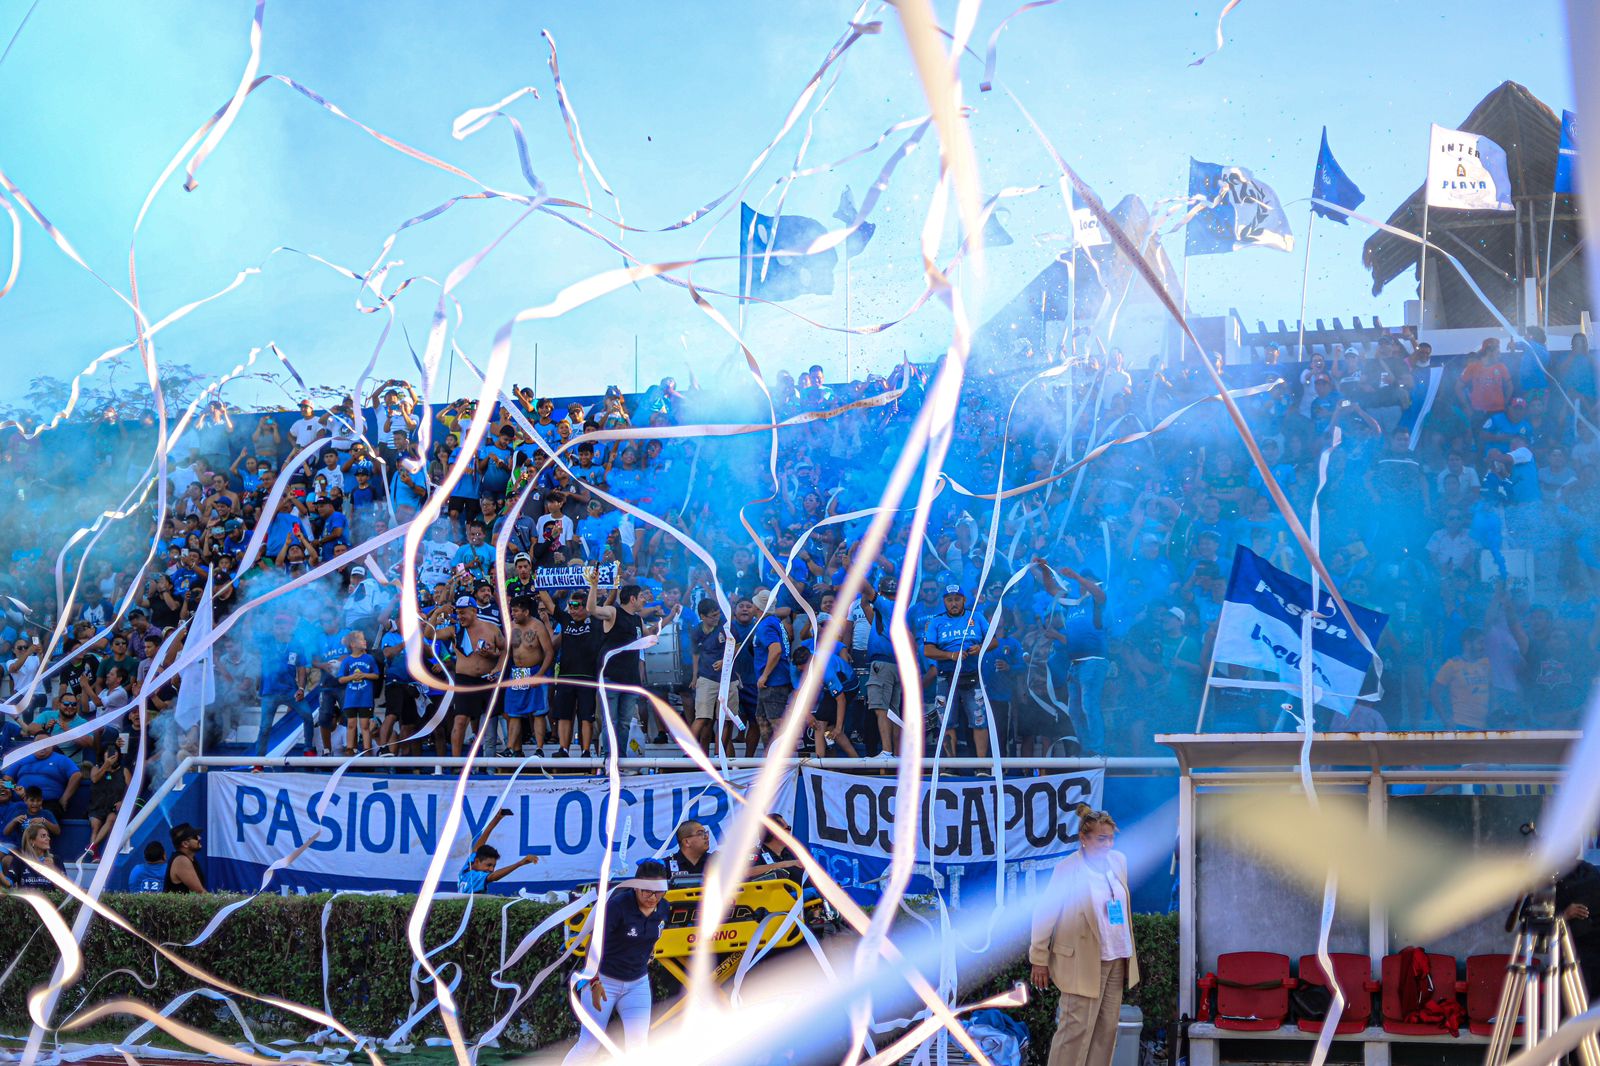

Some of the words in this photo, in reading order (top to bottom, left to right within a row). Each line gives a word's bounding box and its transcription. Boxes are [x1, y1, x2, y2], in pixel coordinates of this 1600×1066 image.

[1441, 143, 1481, 159] INTER
[1442, 180, 1487, 190] PLAYA
[535, 574, 586, 587] VILLANUEVA
[941, 629, 976, 639] SIMCA
[235, 780, 437, 857] PASIÓN
[462, 795, 498, 852] Y
[518, 786, 745, 857] LOCUR
[921, 776, 1092, 856] CAPOS
[142, 881, 159, 890] 12
[715, 949, 745, 976] stryke
